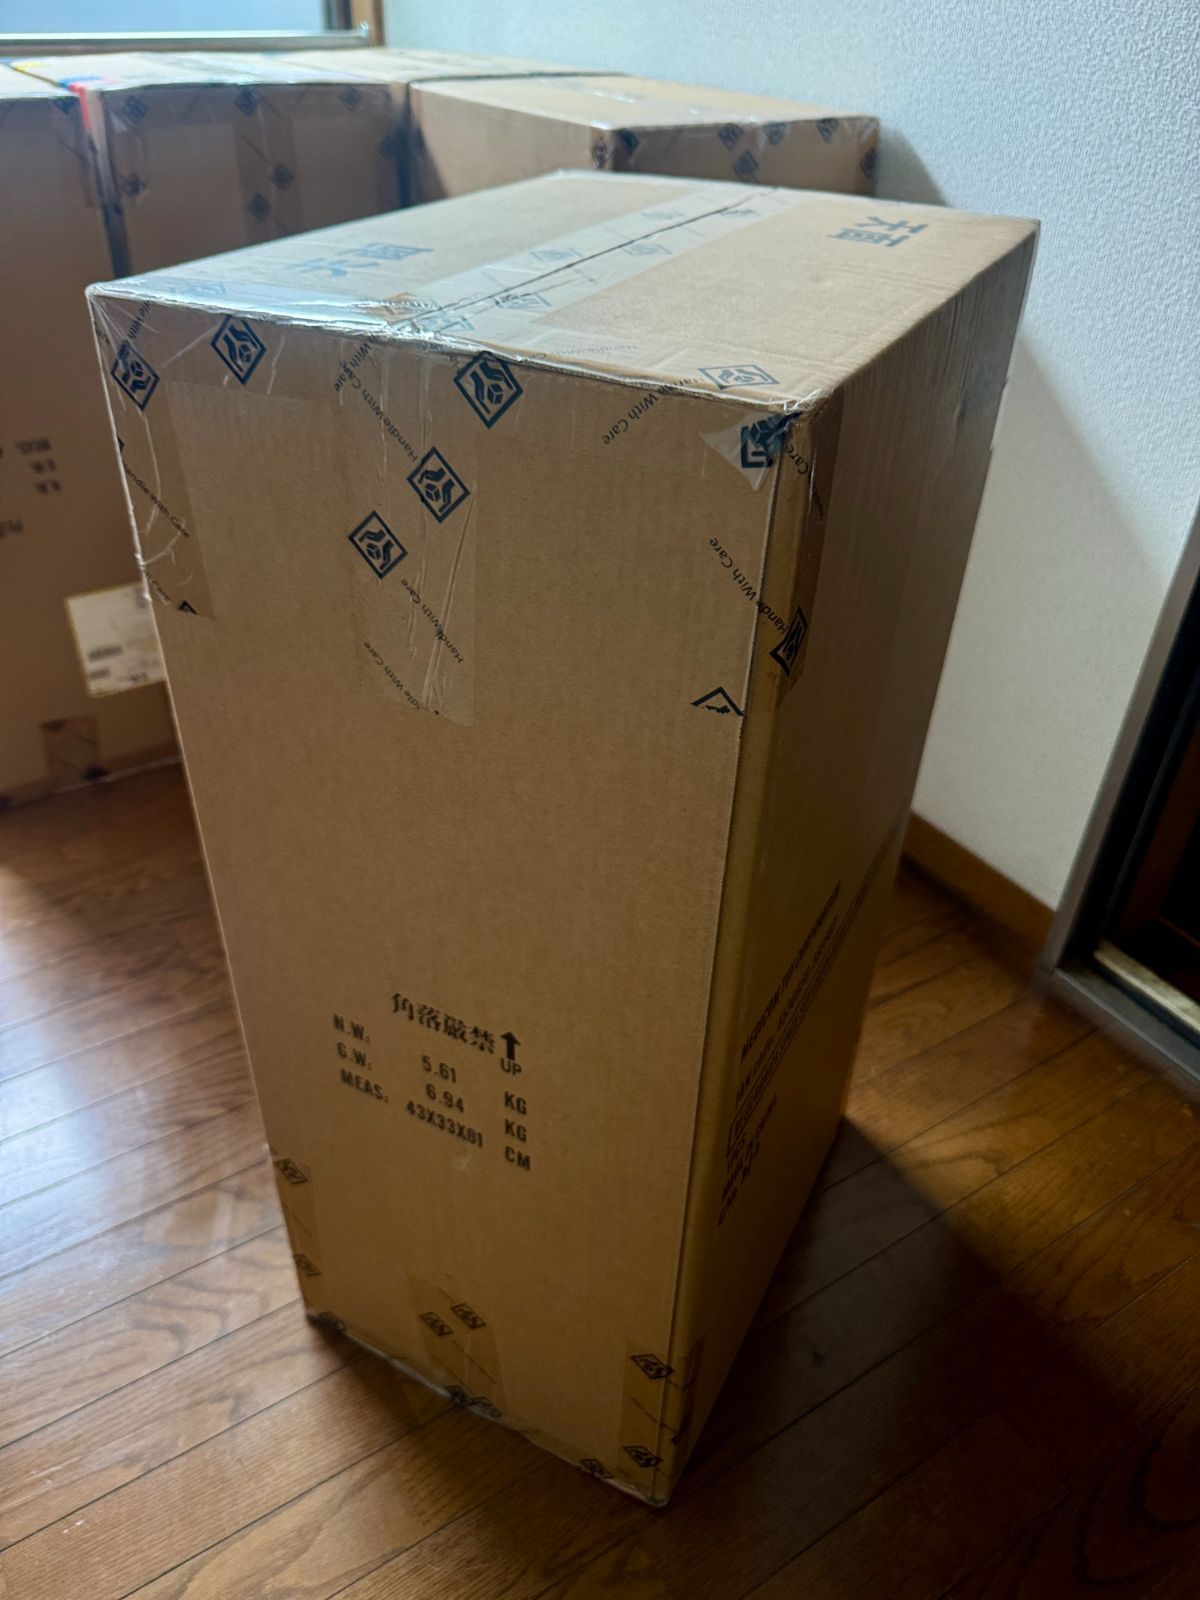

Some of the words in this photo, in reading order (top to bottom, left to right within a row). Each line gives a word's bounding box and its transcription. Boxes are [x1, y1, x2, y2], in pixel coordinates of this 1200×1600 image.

[359, 388, 385, 419] With
[626, 392, 657, 421] With
[381, 416, 419, 462] Handle
[600, 418, 630, 446] Care
[782, 442, 810, 475] Care
[706, 536, 734, 568] Care
[398, 577, 421, 604] Care
[730, 568, 758, 600] With
[362, 640, 384, 665] Care
[382, 665, 404, 690] With
[500, 1058, 521, 1075] UP
[422, 1055, 456, 1083] 5.61
[504, 1091, 527, 1115] KG
[426, 1083, 464, 1113] 6.94
[504, 1119, 527, 1142] KG
[505, 1146, 531, 1170] CM
